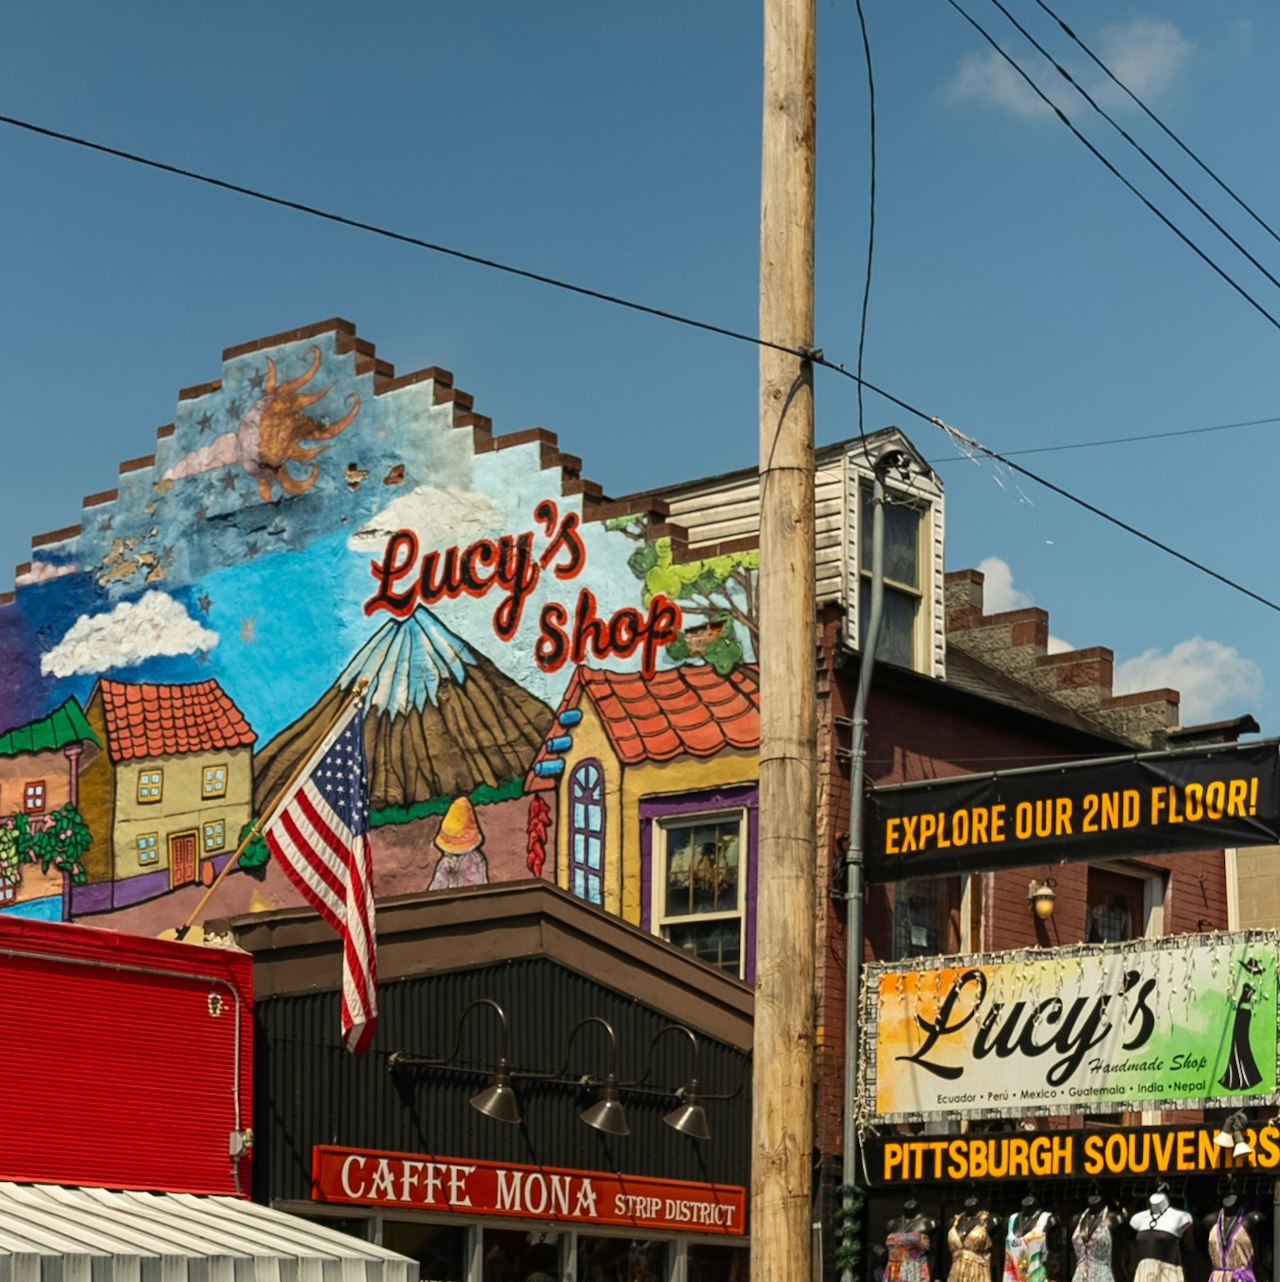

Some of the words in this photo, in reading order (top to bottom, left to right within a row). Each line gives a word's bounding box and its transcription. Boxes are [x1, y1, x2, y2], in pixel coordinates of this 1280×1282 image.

[365, 499, 585, 641] Lucy's
[885, 804, 1006, 855] EXPLORE
[1015, 797, 1073, 840] OUR
[1083, 789, 1141, 832] 2ND
[1151, 777, 1259, 824] FLOOR!
[895, 968, 1157, 1088] Lucy's
[937, 1092, 976, 1105] Ecuador
[987, 1089, 1009, 1102] Perú
[1020, 1088, 1057, 1100] Mexico
[1069, 1085, 1125, 1098] Guatemala
[1138, 1082, 1163, 1093] India
[1174, 1080, 1206, 1094] Nepal
[1088, 1056, 1165, 1074] Handmade
[1169, 1053, 1208, 1070] Shop
[884, 1135, 1073, 1181] PITTSBURGH
[495, 1169, 598, 1217] MONA
[614, 1194, 662, 1219] STRIP
[664, 1198, 736, 1227] DISTRICT
